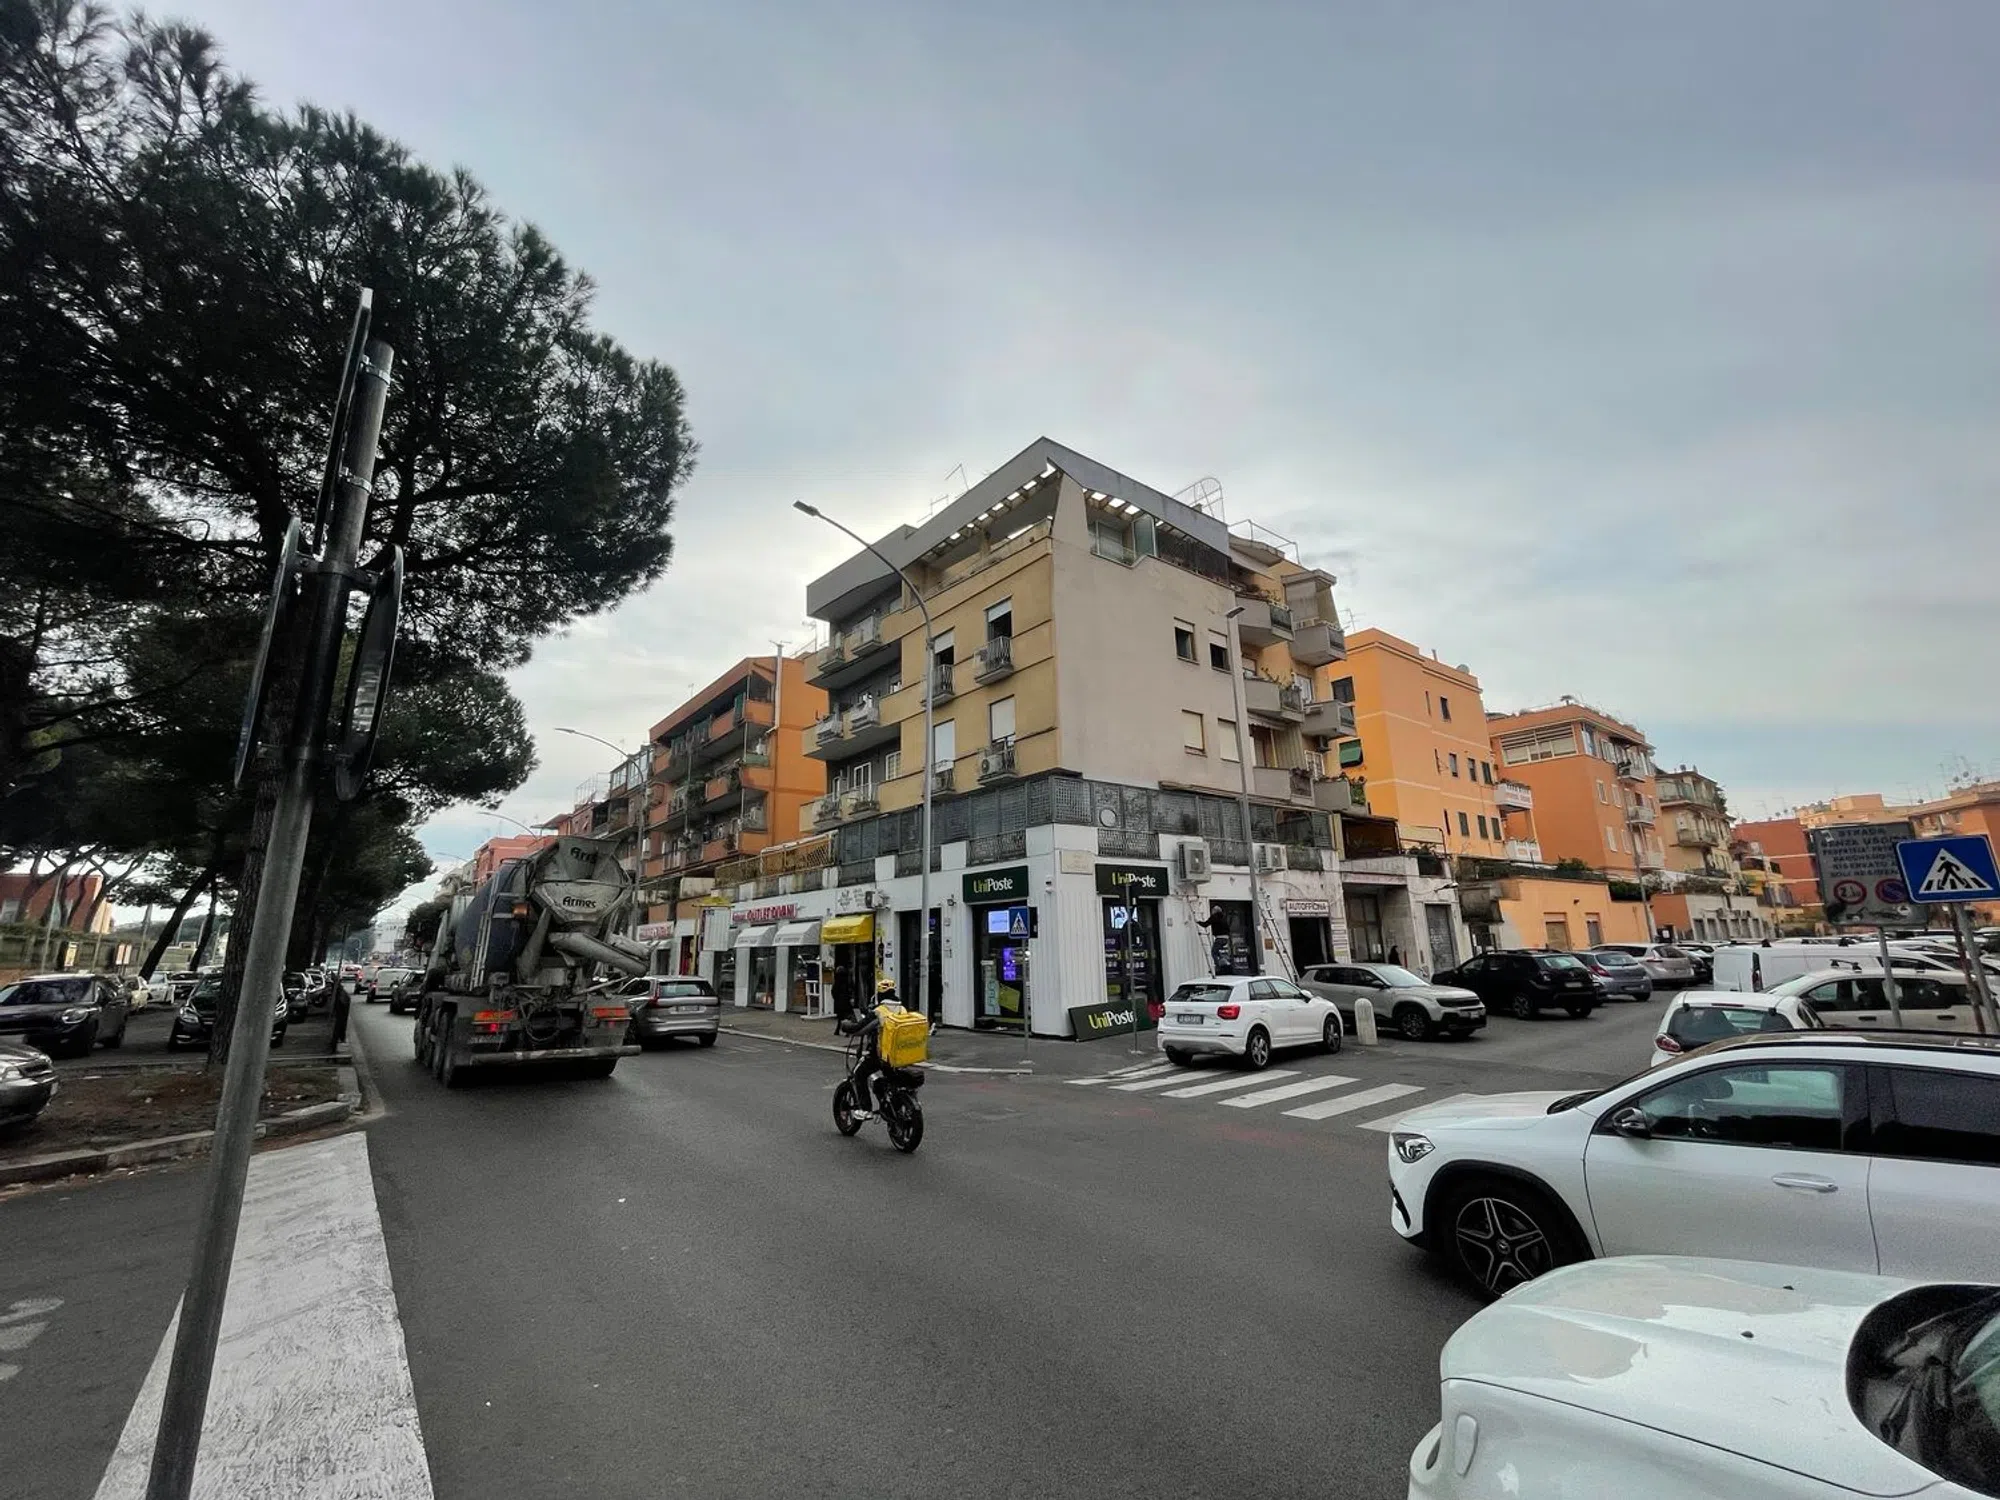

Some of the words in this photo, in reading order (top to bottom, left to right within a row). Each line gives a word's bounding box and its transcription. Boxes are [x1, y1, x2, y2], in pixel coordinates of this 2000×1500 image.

[1837, 828, 1887, 838] STRADA
[1854, 868, 1899, 876] RESIDEN
[973, 877, 1014, 893] UniPoste
[1288, 902, 1329, 911] AUTOFFICINA
